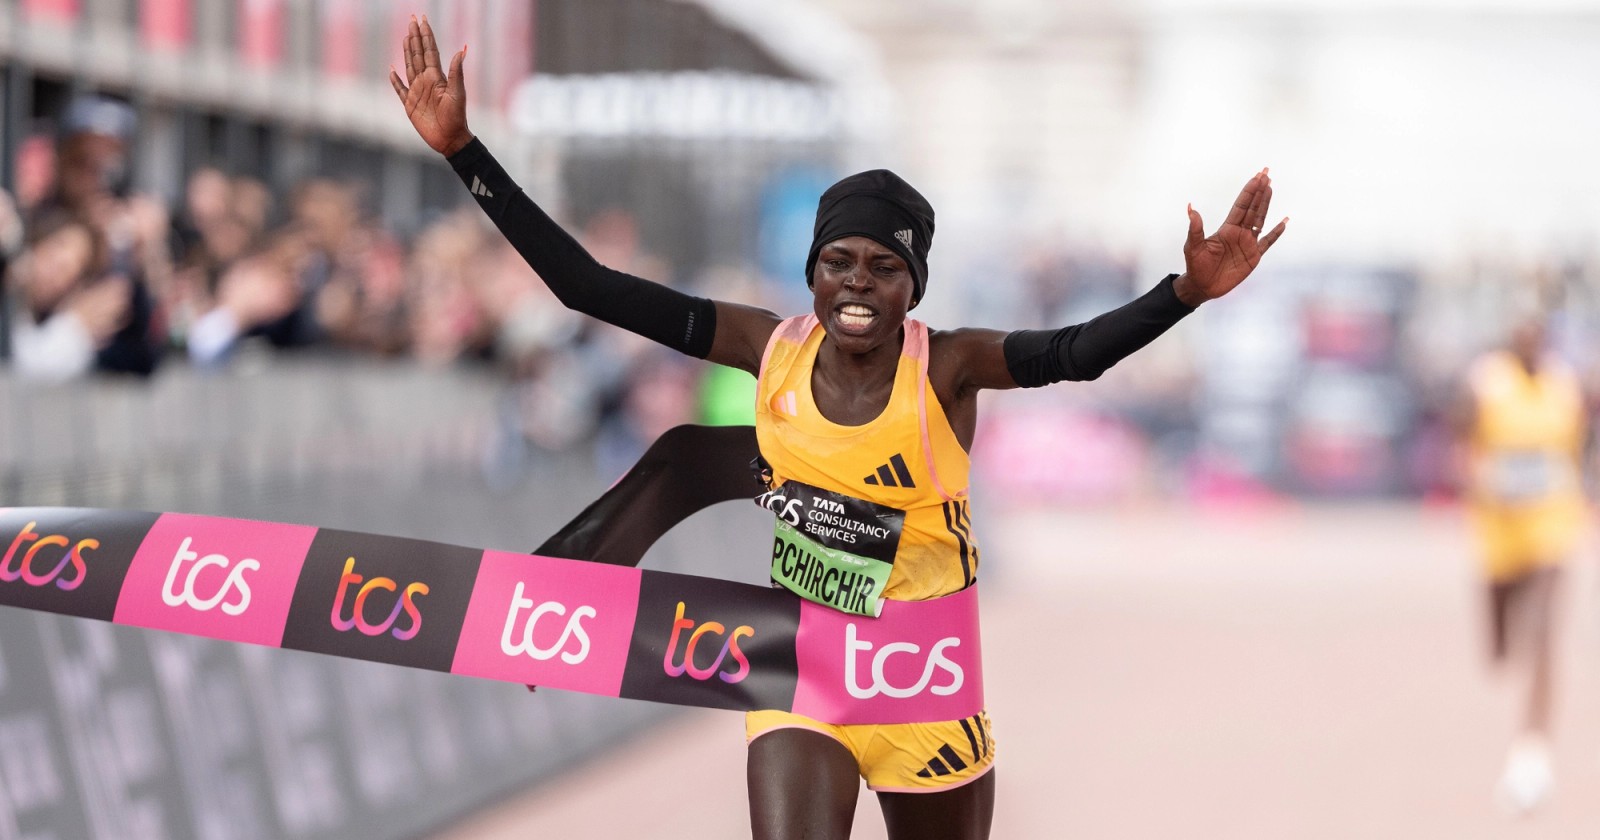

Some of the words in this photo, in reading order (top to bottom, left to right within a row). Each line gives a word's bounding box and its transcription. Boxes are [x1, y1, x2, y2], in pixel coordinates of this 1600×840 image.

[812, 496, 845, 515] TATA
[805, 522, 857, 544] SERVICES
[808, 509, 890, 540] CONSULTANCY
[0, 521, 99, 591] tcs
[161, 537, 261, 616] tcs
[330, 557, 430, 641] tcs
[500, 581, 597, 665] tcs
[663, 601, 755, 684] tcs
[844, 623, 964, 699] tcs
